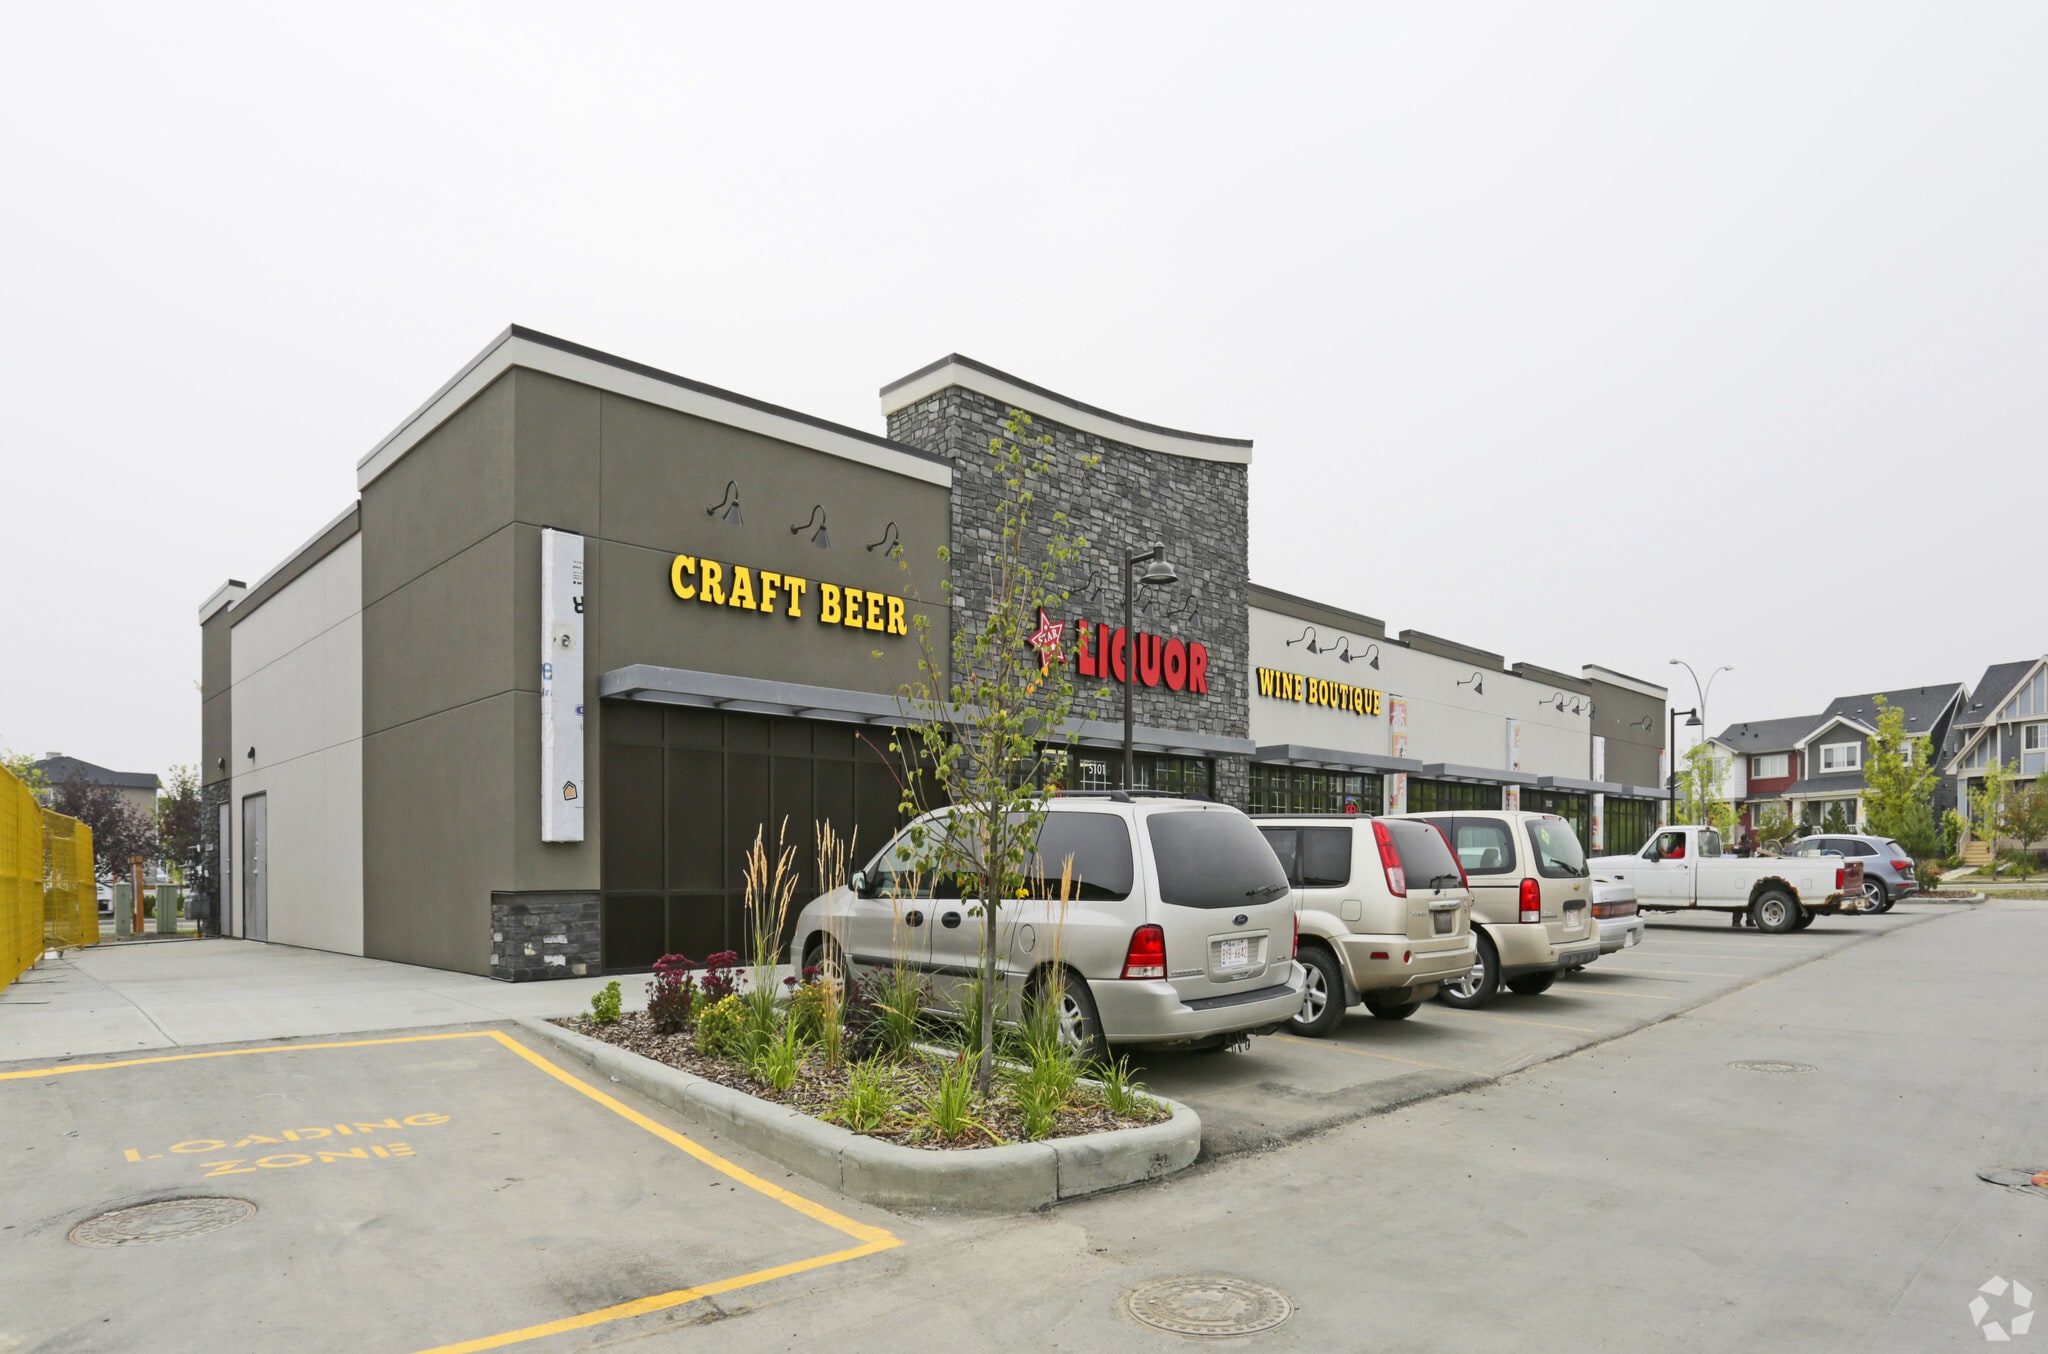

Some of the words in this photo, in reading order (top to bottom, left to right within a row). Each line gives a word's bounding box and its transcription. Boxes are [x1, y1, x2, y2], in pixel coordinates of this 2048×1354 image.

[671, 553, 807, 618] CRAFT
[819, 582, 908, 636] BEER
[1037, 628, 1058, 645] STAR
[1078, 619, 1208, 694] LIQUOR
[1256, 667, 1303, 702] WINE
[1306, 677, 1381, 715] BOUTIQUE
[1088, 763, 1106, 775] 5101
[124, 1112, 451, 1163] LOADING
[200, 1142, 417, 1178] ZONE
